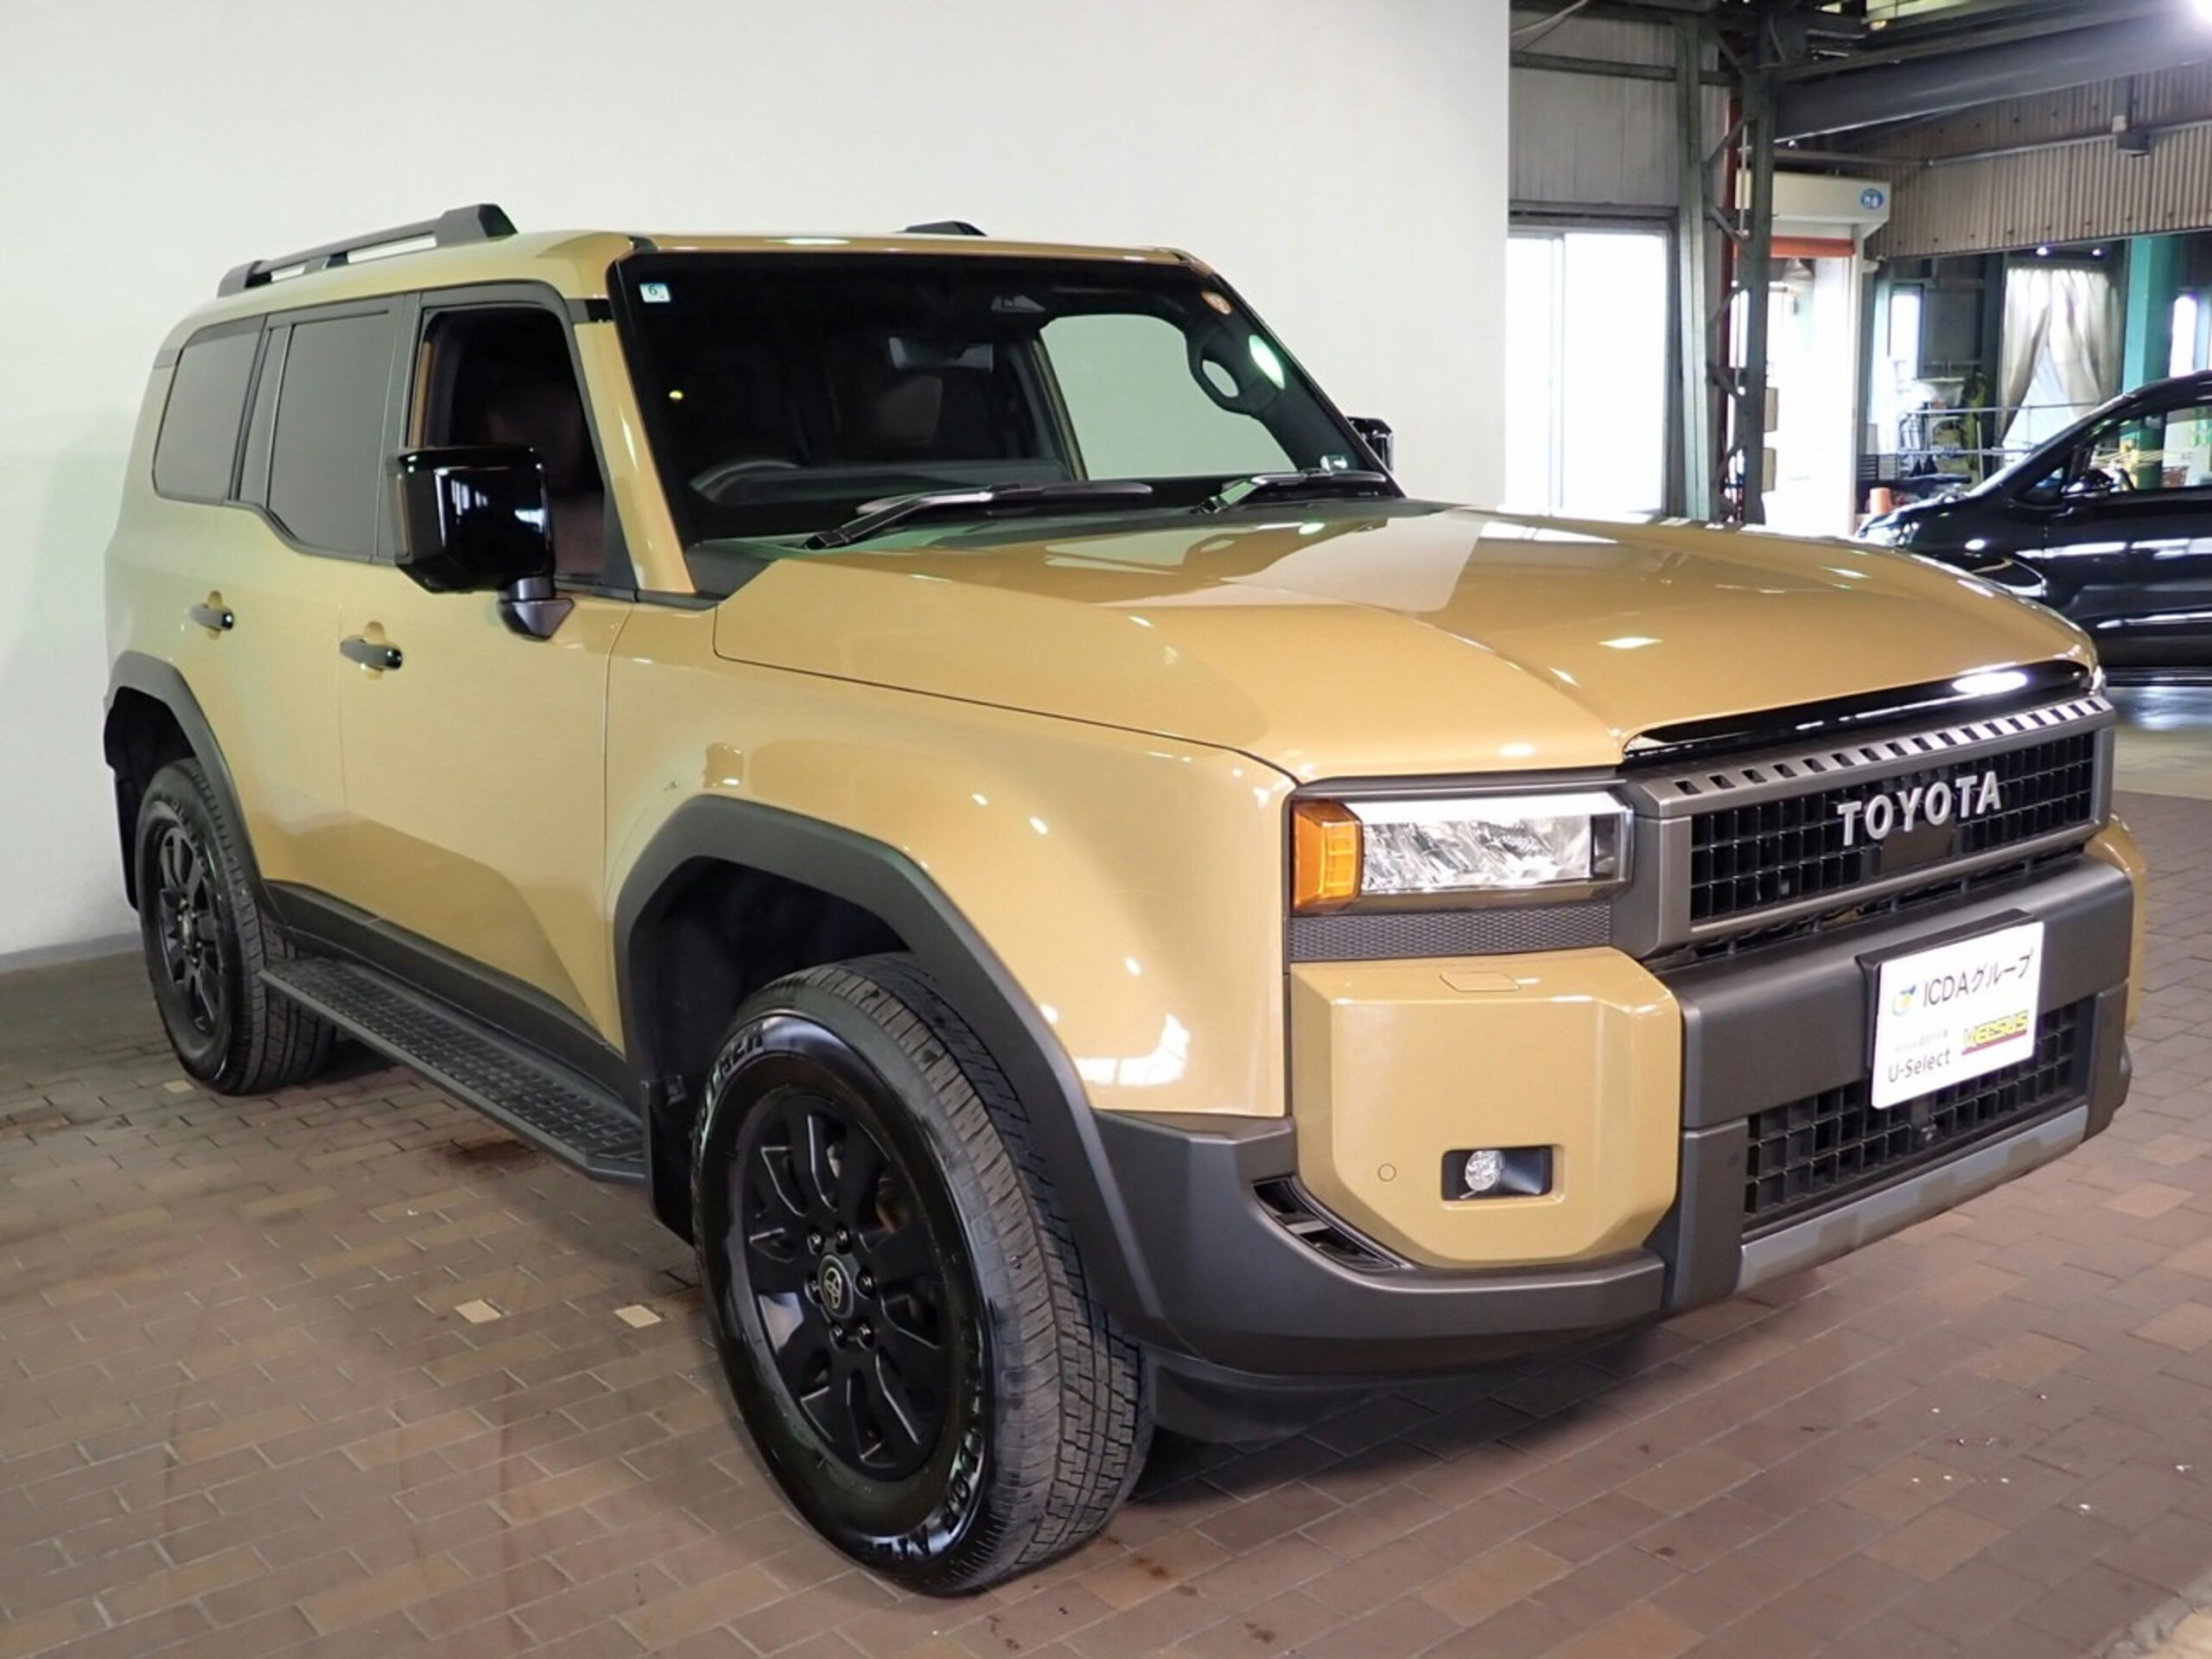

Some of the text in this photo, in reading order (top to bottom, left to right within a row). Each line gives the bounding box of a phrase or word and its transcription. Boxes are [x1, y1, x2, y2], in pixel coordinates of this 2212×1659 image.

[1837, 771, 2001, 846] TOYOTA
[1923, 948, 2035, 1008] ICDAグループ
[1888, 1048, 1951, 1084] U-Select
